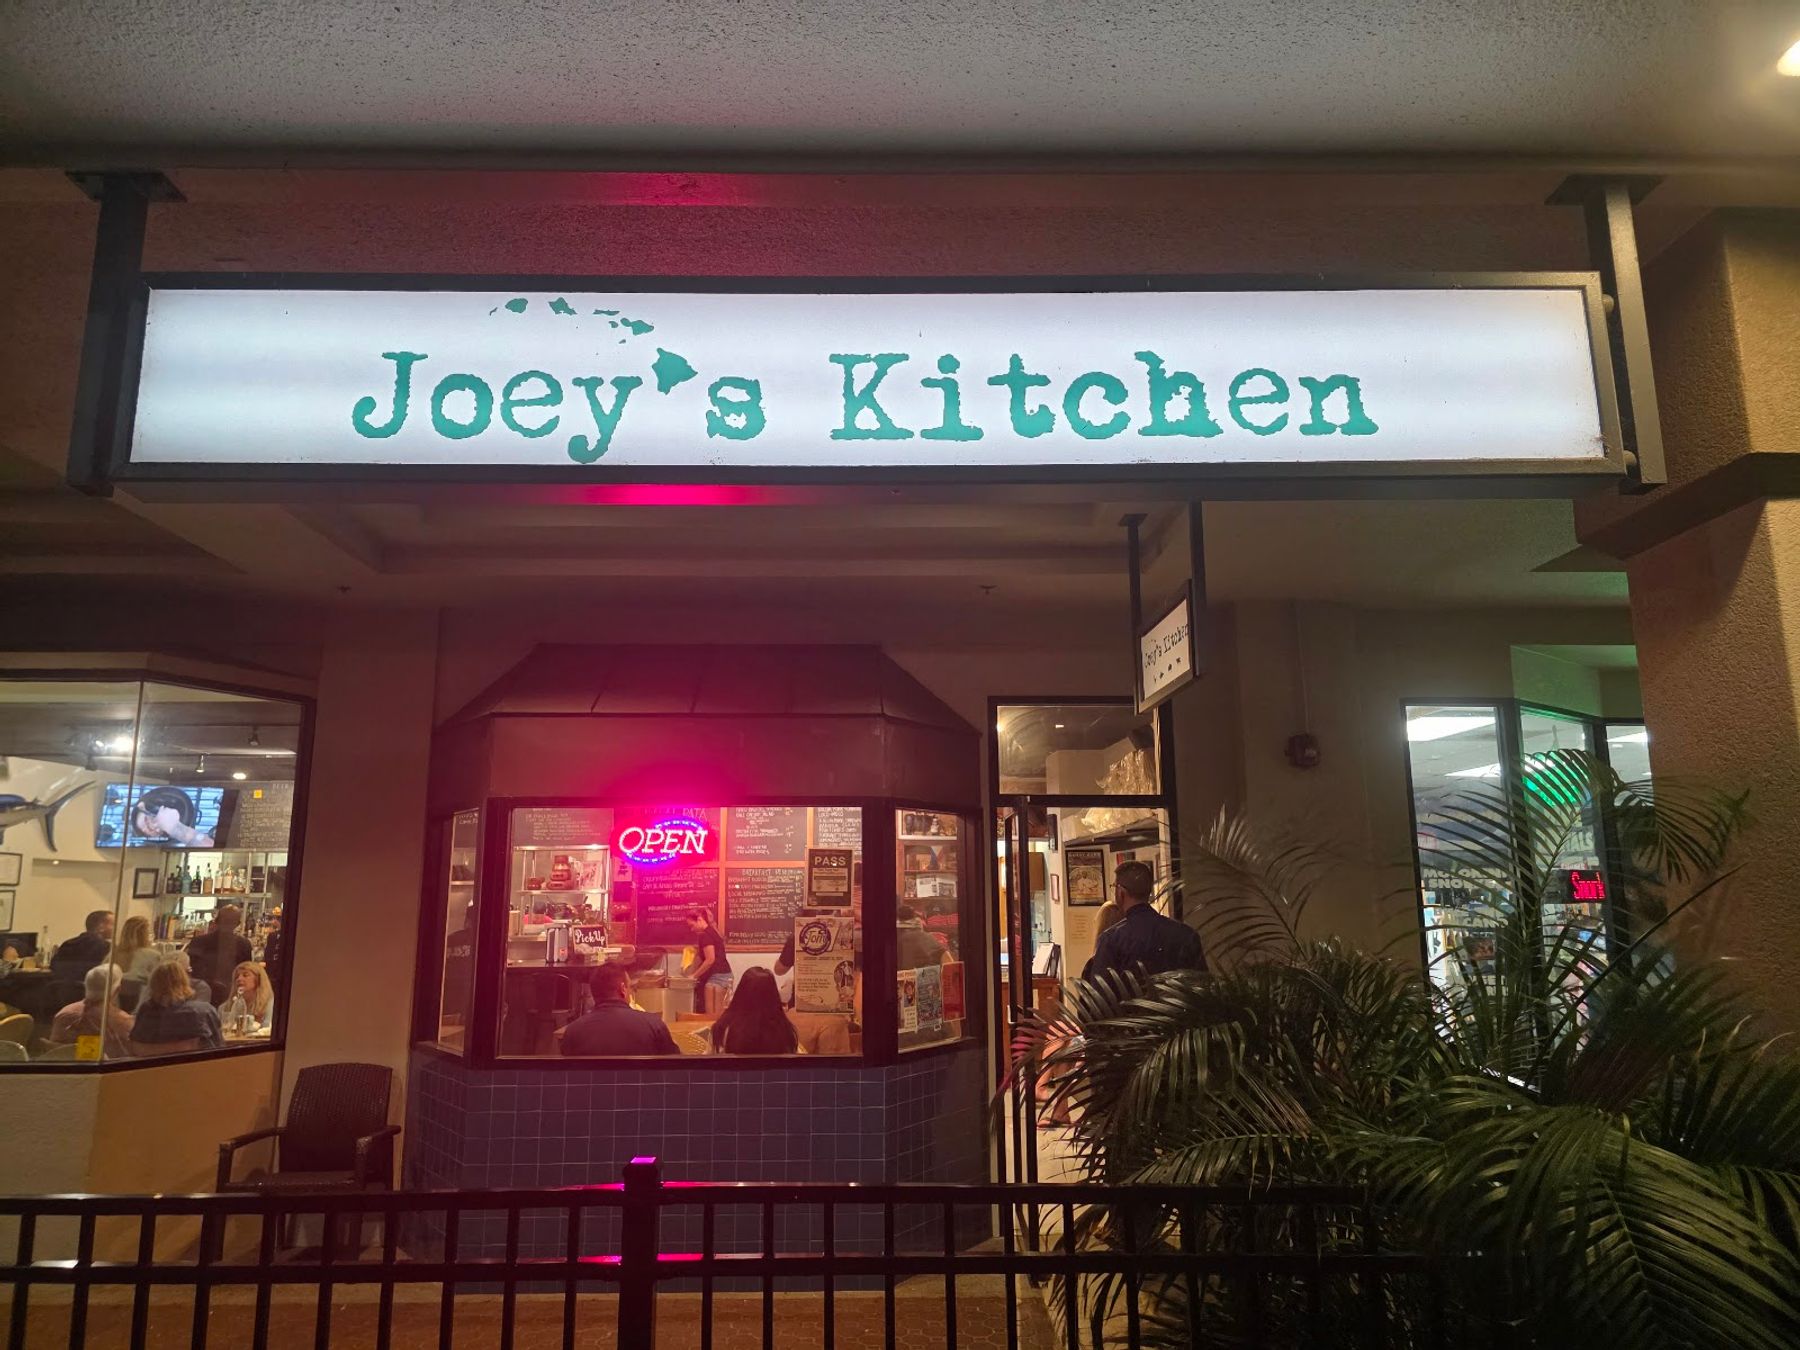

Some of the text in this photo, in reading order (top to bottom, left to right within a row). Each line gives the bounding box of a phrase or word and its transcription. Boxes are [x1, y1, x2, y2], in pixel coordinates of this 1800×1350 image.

[352, 347, 1379, 464] Joey's Kitchen
[1163, 624, 1189, 654] Kitchen
[618, 826, 709, 855] OPEN
[814, 856, 846, 866] PASS
